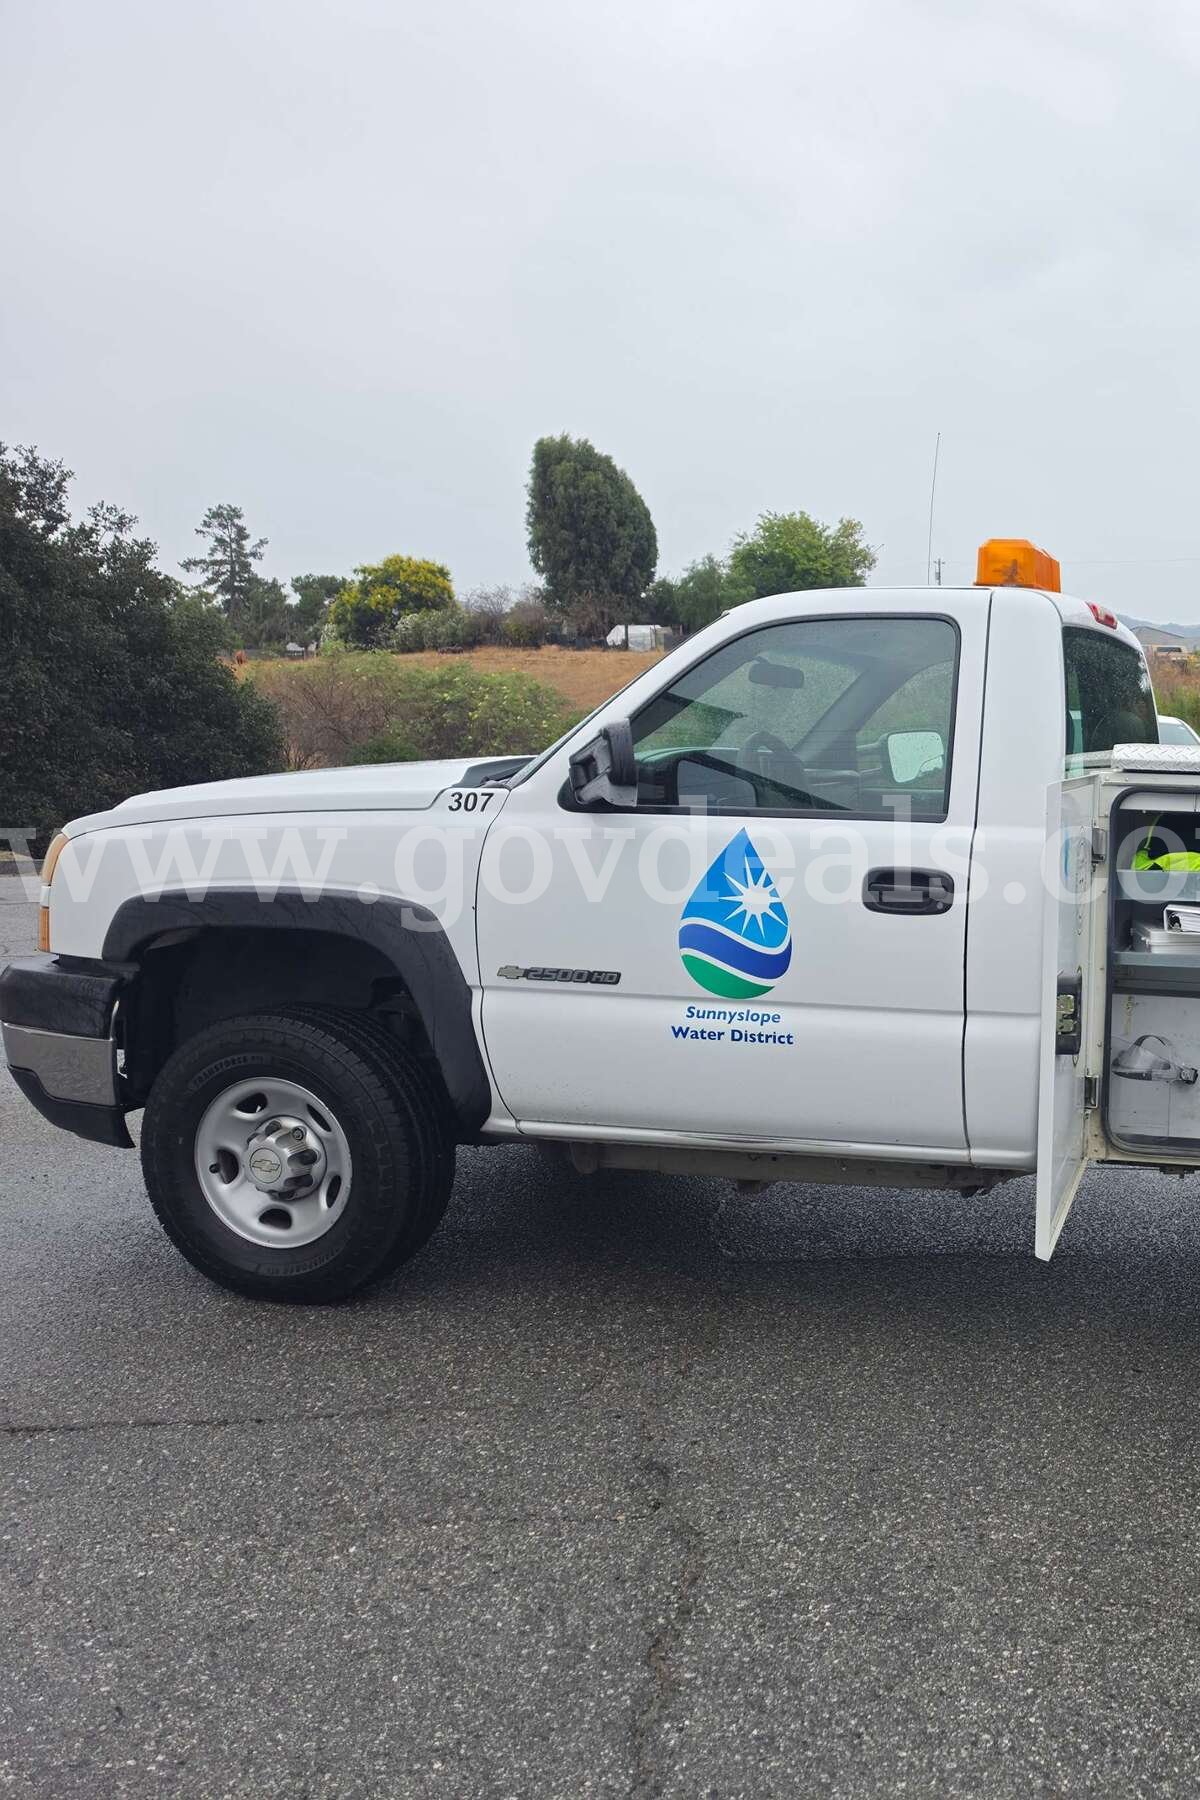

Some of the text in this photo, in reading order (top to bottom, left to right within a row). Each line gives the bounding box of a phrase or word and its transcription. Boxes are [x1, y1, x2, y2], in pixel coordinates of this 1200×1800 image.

[448, 791, 494, 812] 307
[527, 967, 619, 984] 2500 HD
[686, 1006, 781, 1026] Sunnyslope
[671, 1025, 794, 1045] Water District
